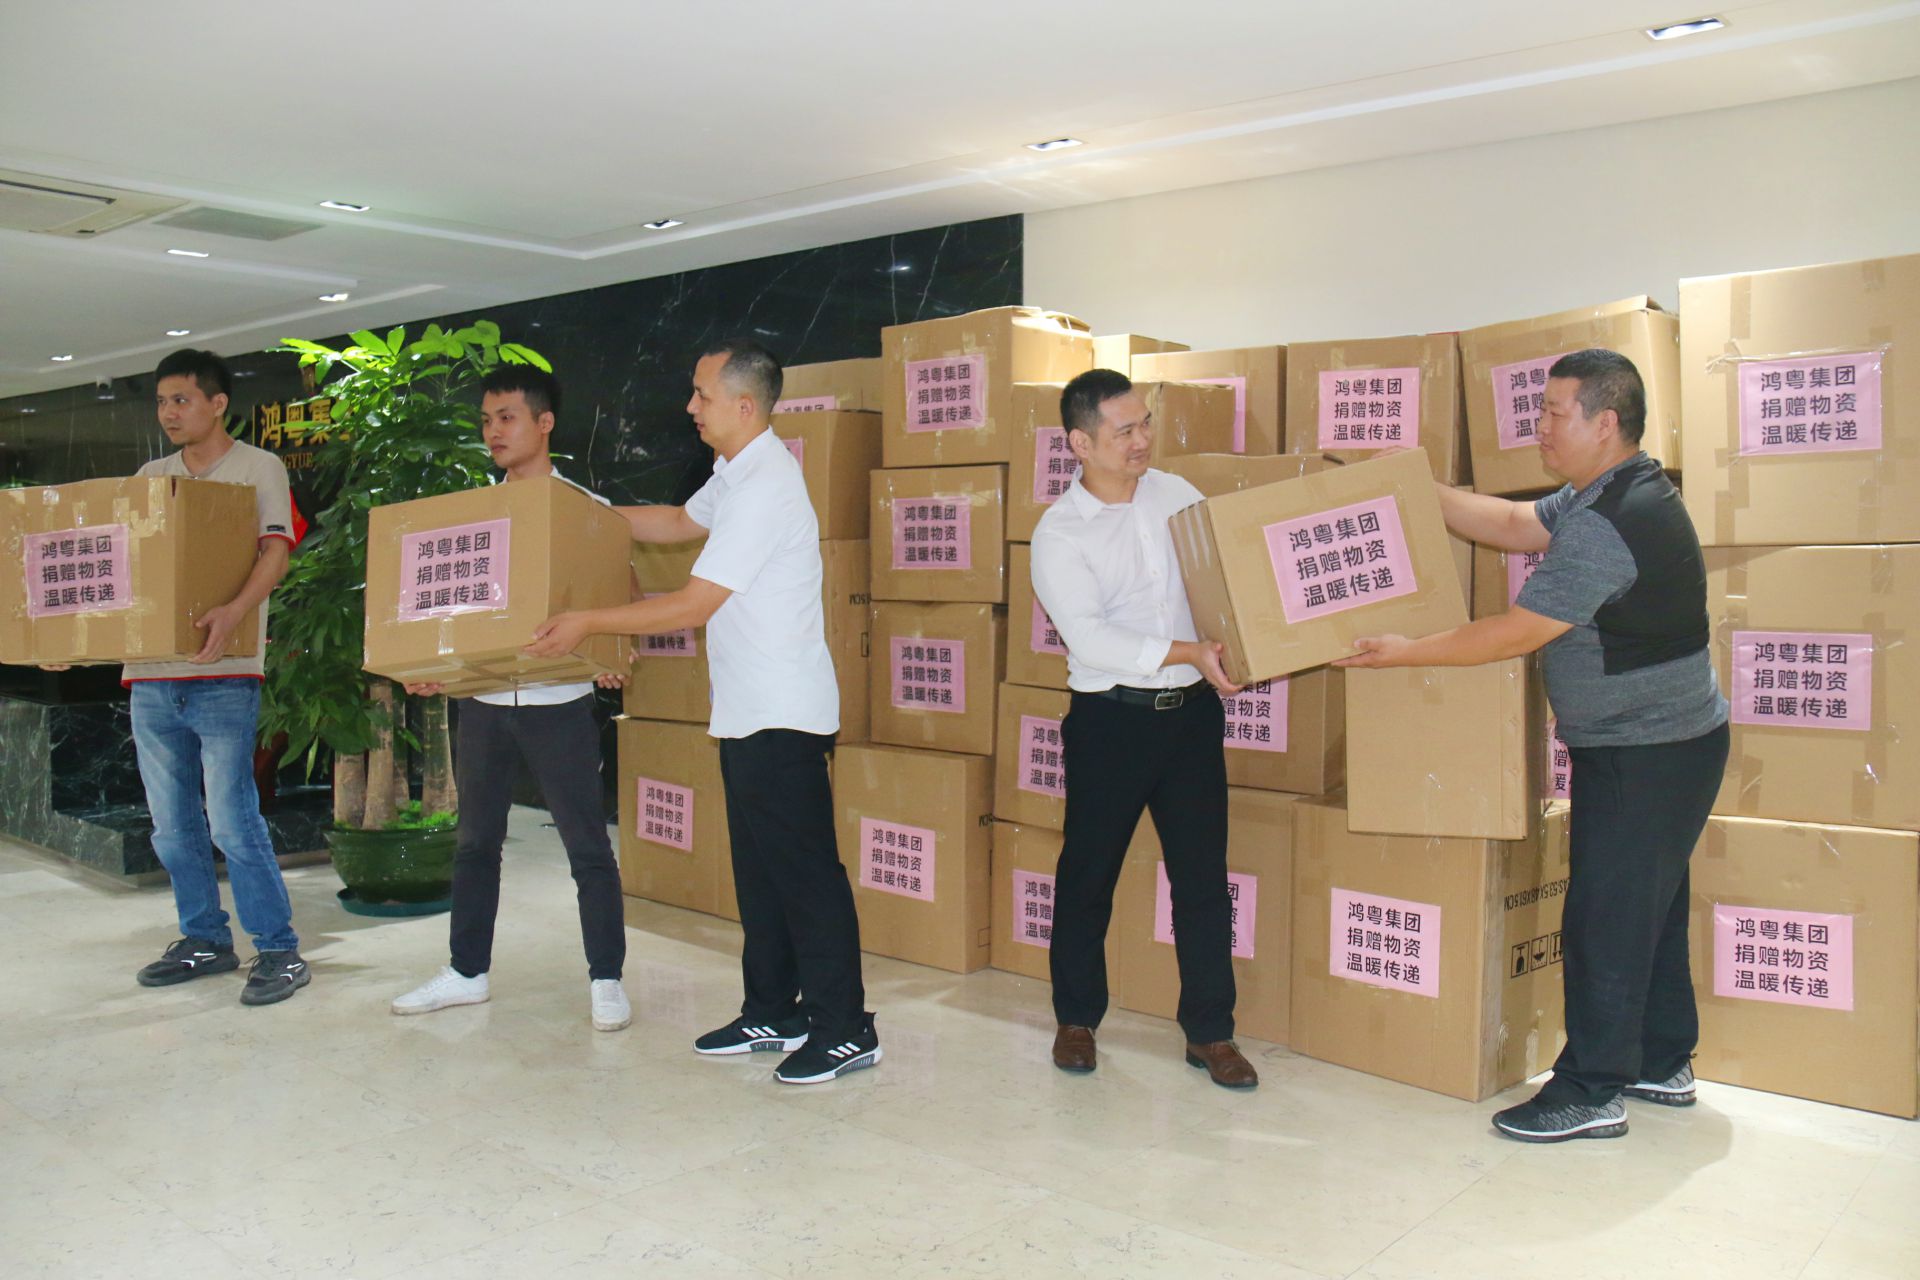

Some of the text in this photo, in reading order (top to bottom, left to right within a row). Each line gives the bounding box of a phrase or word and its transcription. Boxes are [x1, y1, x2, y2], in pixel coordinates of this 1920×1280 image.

[918, 364, 970, 384] 鸿粤集团
[1761, 365, 1855, 391] 鸿粤集团
[918, 385, 970, 404] 捐赠物资
[1336, 378, 1401, 396] 鸿粤集团
[919, 405, 972, 424] 温暖传递
[1335, 401, 1401, 418] 捐赠物资
[1761, 393, 1856, 419] 捐赠物资
[1334, 424, 1400, 440] 温暖传递
[1762, 420, 1857, 445] 温暖传递
[905, 505, 956, 521] 鸿粤集团
[904, 526, 956, 541] 捐赠物资
[1289, 512, 1380, 552] 鸿粤集团
[42, 535, 111, 559] 鸿粤集团
[418, 531, 490, 560] 鸿粤集团
[905, 546, 957, 561] 温暖传递
[43, 560, 112, 583] 捐赠物资
[417, 557, 489, 585] 捐赠物资
[1296, 540, 1387, 580] 捐赠物资
[45, 583, 115, 607] 温暖传递
[416, 582, 489, 610] 温暖传递
[1304, 567, 1394, 607] 温暖传递
[902, 646, 951, 663] 鸿粤集团
[1755, 642, 1847, 664] 鸿粤集团
[902, 666, 951, 683] 捐赠物资
[1754, 669, 1847, 691] 捐赠物资
[903, 686, 952, 704] 温暖传递
[1754, 696, 1847, 718] 温暖传递
[647, 787, 683, 807] 鸿粤集团
[646, 803, 683, 824] 捐赠物资
[646, 821, 682, 842] 温暖传递
[873, 828, 922, 852] 鸿粤集团
[872, 848, 921, 872] 捐赠物资
[872, 868, 921, 892] 温暖传递
[1349, 902, 1420, 933] 鸿粤集团
[1348, 927, 1420, 958] 捐赠物资
[1736, 918, 1828, 945] 鸿粤集团
[1347, 952, 1419, 984] 温暖传递
[1735, 944, 1828, 971] 捐赠物资
[1735, 970, 1828, 998] 温暖传递
